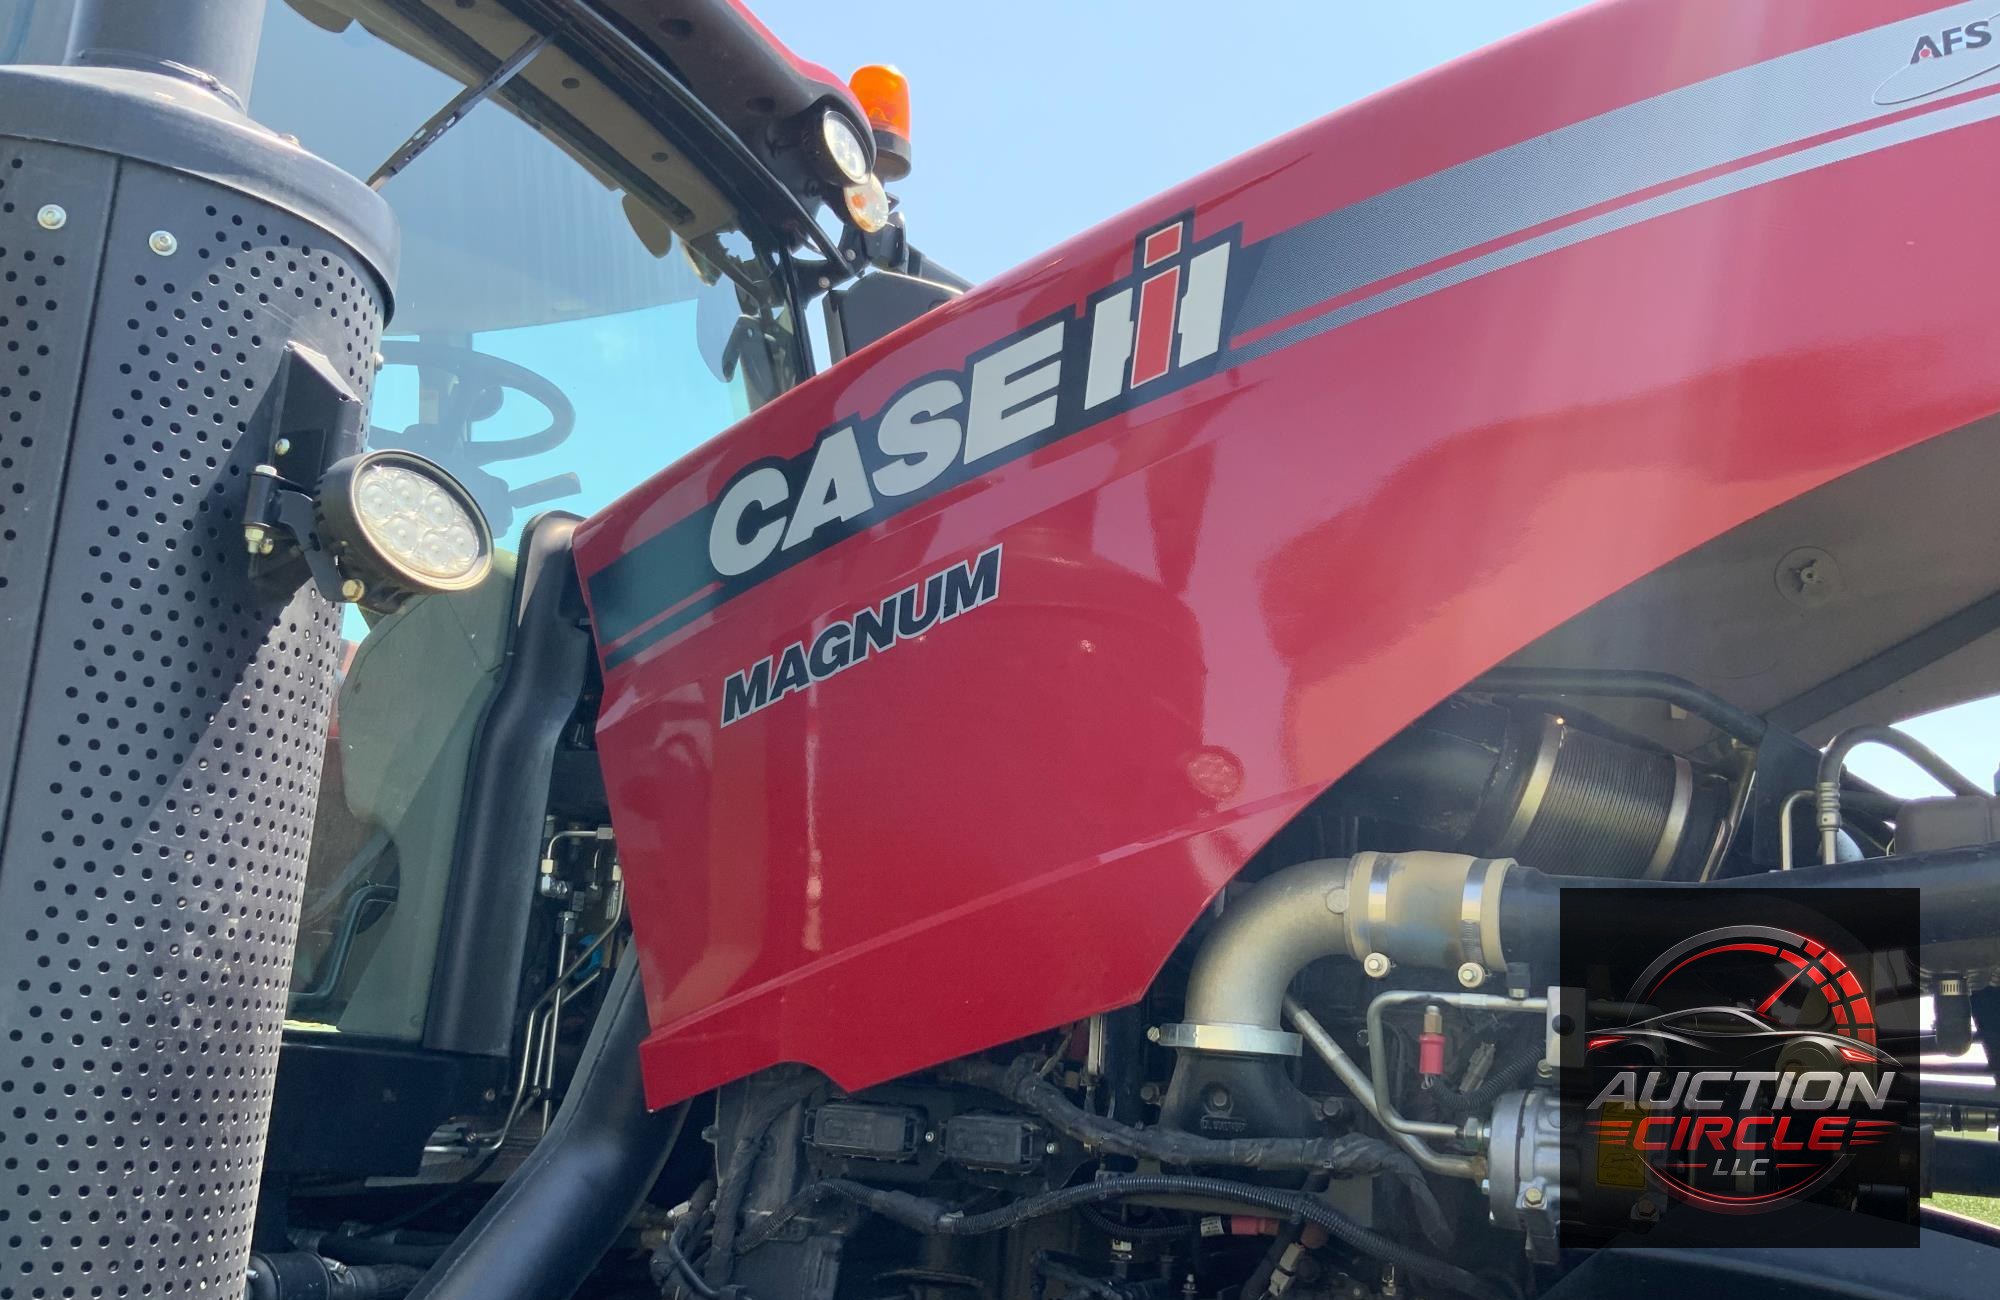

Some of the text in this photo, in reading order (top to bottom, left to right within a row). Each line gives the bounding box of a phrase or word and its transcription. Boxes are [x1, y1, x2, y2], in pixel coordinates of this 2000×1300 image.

[1910, 20, 1992, 65] AFS
[708, 320, 1066, 577] CASE
[720, 542, 1004, 729] MAGNUM
